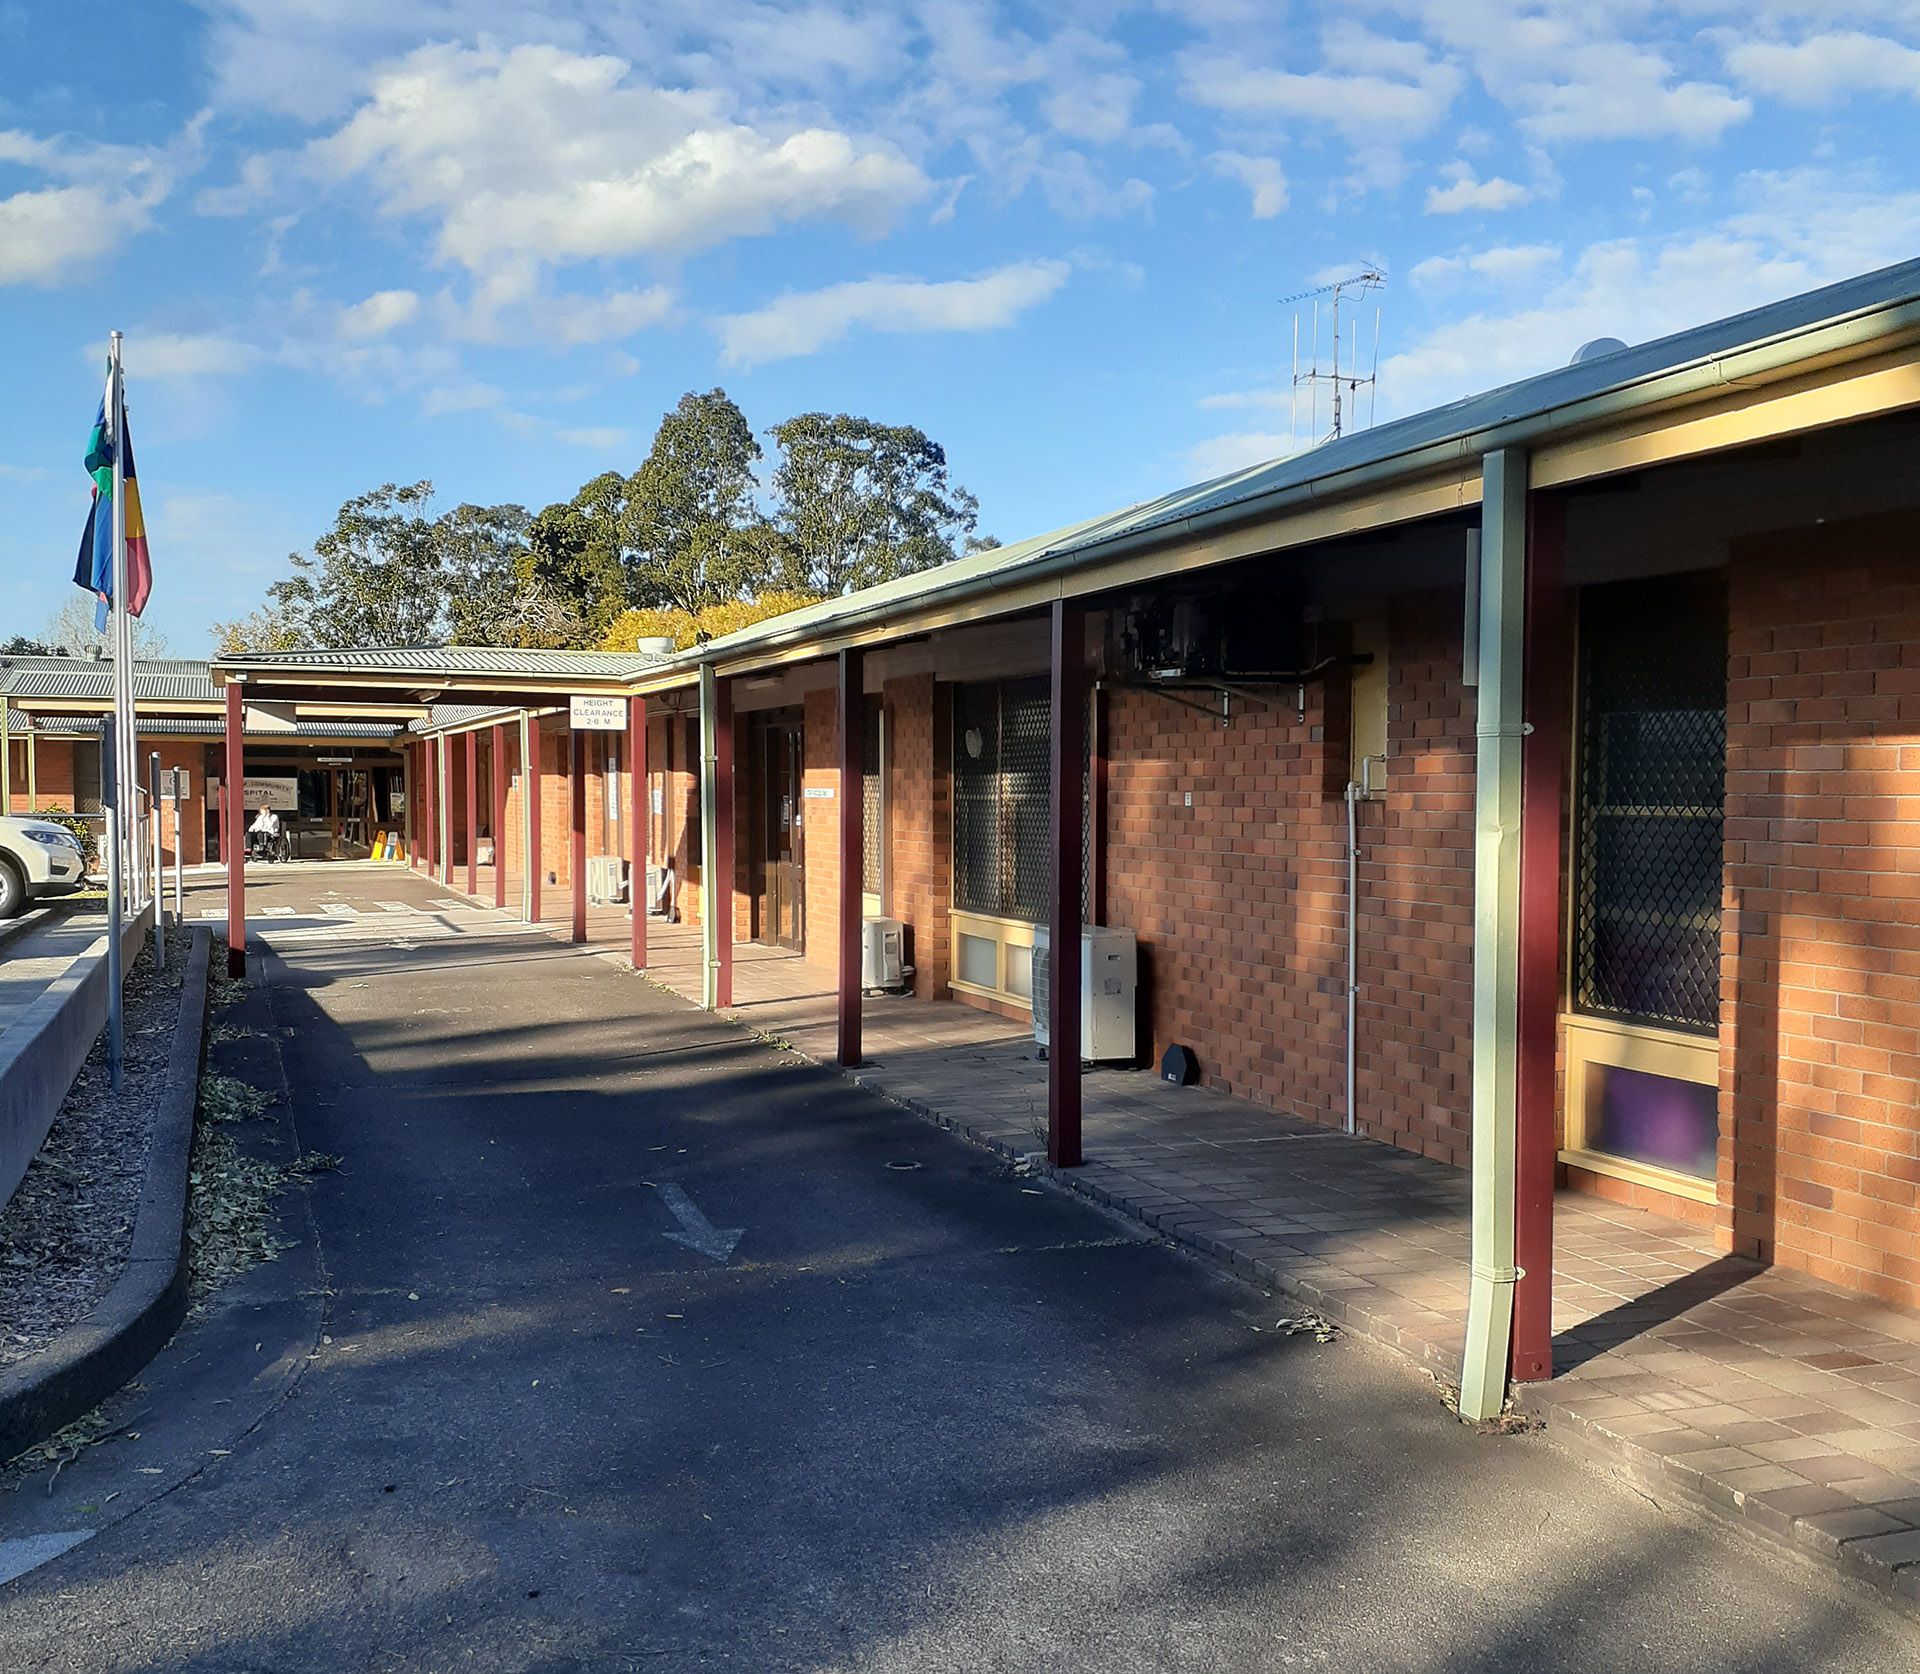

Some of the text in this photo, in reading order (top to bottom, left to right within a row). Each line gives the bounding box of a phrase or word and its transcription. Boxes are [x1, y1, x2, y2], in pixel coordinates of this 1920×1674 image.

[583, 699, 614, 707] HEIGHT
[573, 708, 624, 717] CLEARANCE
[251, 781, 289, 792] COMMUNITY
